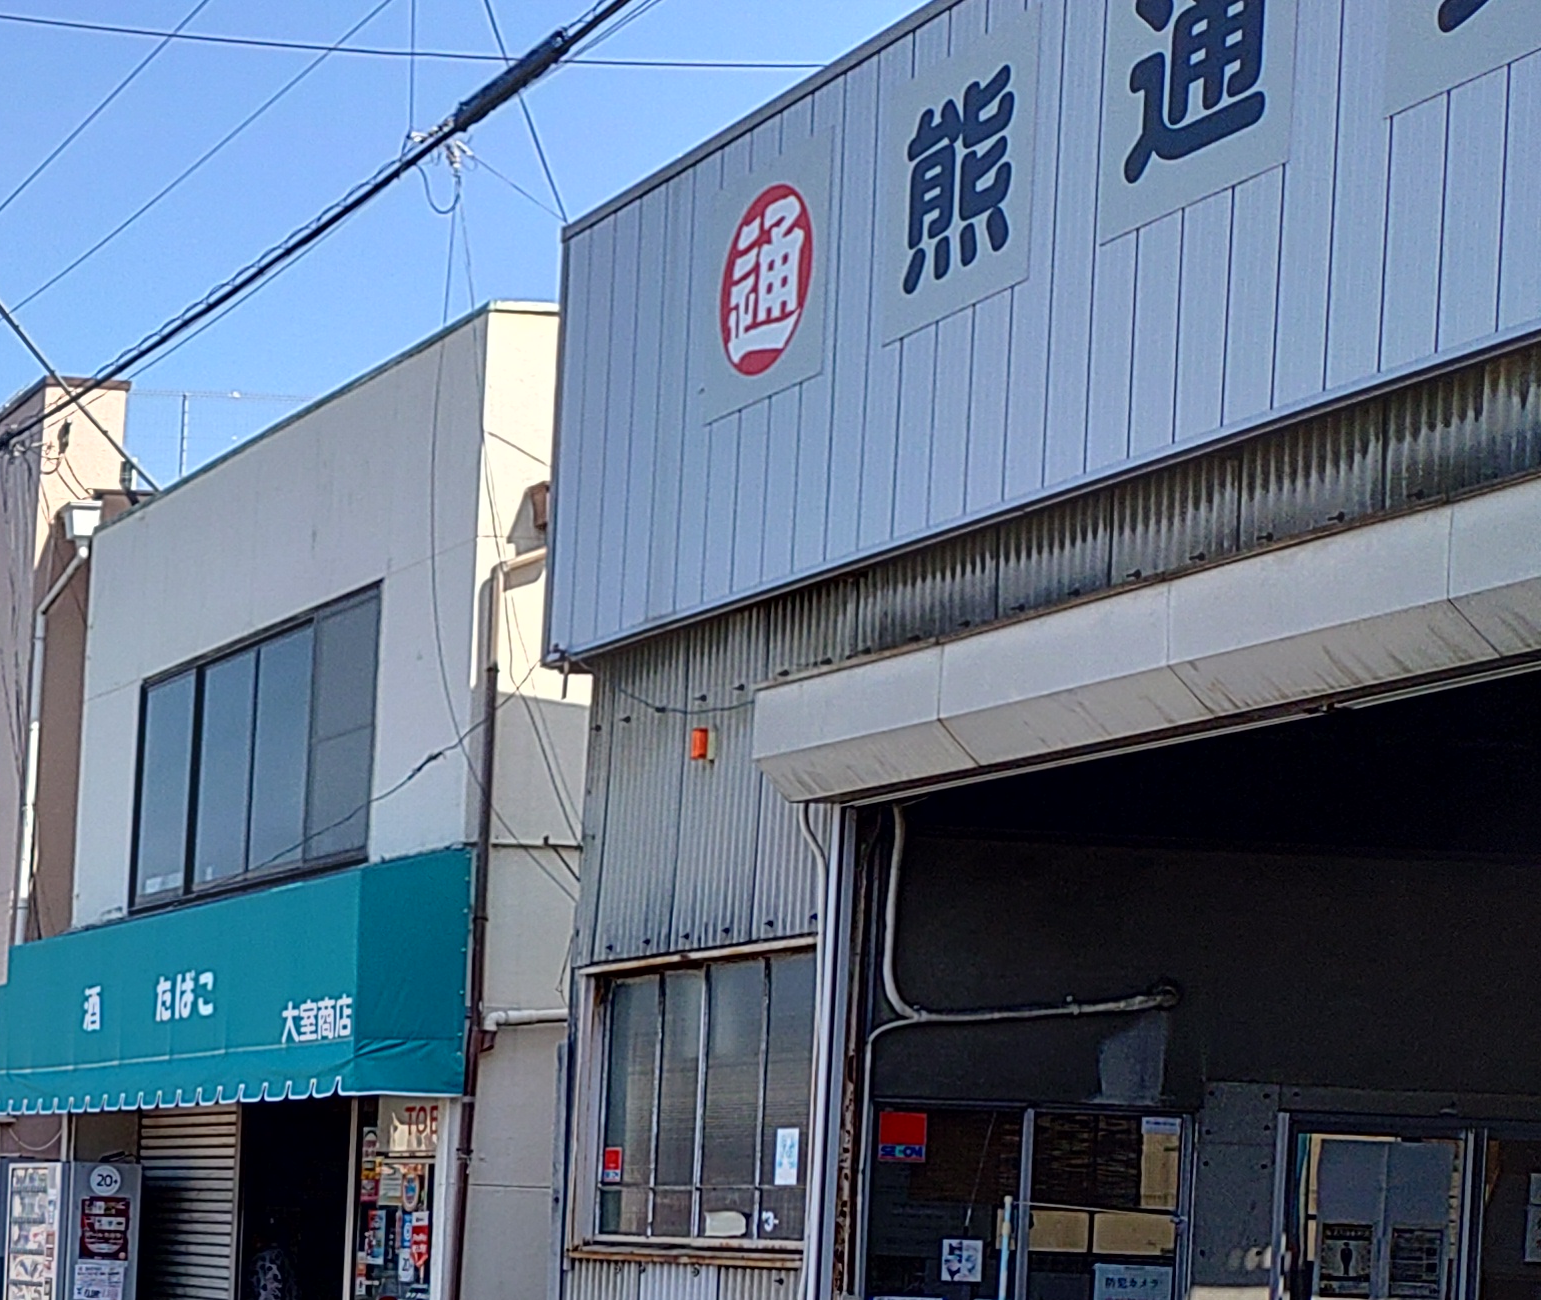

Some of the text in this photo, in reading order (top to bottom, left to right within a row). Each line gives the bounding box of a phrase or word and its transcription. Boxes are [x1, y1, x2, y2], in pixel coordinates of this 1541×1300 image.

[725, 190, 807, 366] 通
[83, 985, 101, 1032] 酒
[155, 970, 214, 1022] たばこ
[281, 993, 353, 1043] 大室商店
